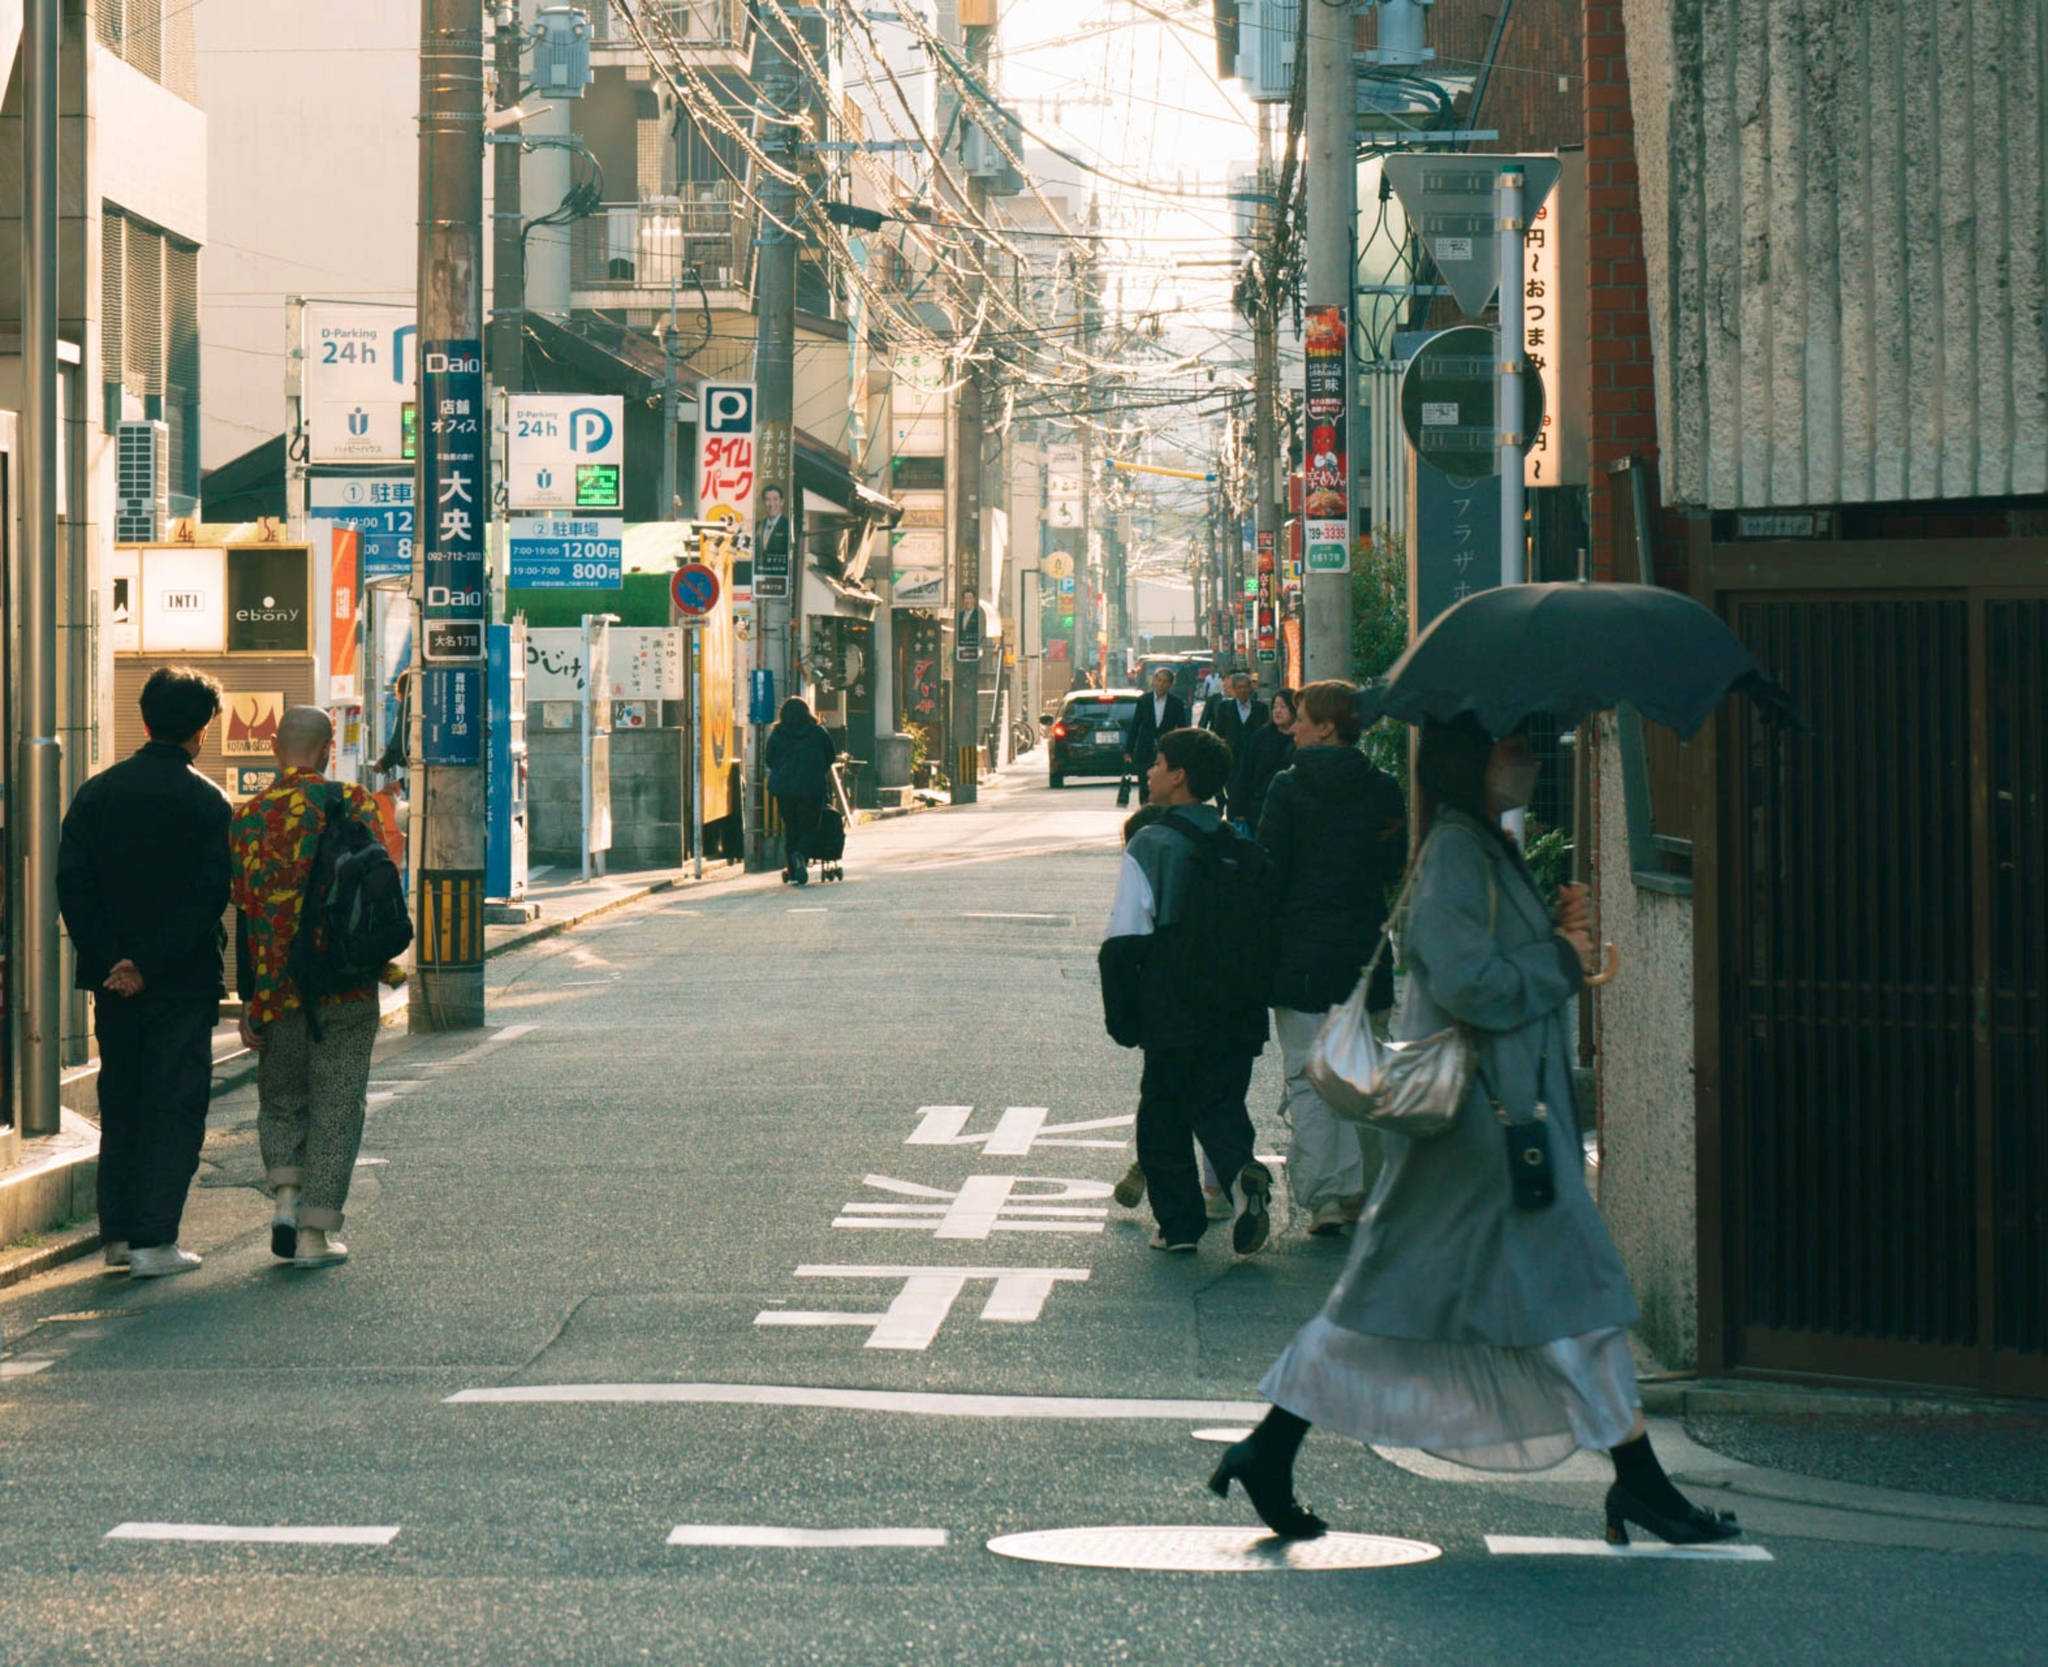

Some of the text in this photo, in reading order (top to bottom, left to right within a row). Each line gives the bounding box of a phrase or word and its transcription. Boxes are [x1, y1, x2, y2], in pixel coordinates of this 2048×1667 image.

[321, 328, 377, 340] D-Parking
[322, 342, 377, 364] 24h
[426, 353, 480, 373] Daio
[1311, 378, 1340, 392] 三味
[440, 400, 470, 415] 店舗
[517, 411, 558, 420] D-Parking
[709, 390, 747, 429] P
[431, 419, 477, 433] オフィス
[518, 420, 557, 437] 24h
[704, 438, 750, 467] タイム
[577, 466, 617, 505] 空
[701, 469, 753, 501] パーク
[1307, 468, 1347, 489] 辛めん
[371, 483, 414, 503] 駐車
[438, 470, 472, 542] 大央
[553, 522, 599, 537] 駐車場
[513, 546, 560, 555] 7:00-19:00
[513, 566, 561, 575] 19:00-7:00
[169, 595, 198, 608] INTI
[427, 586, 481, 606] Daio
[236, 608, 299, 622] ebony
